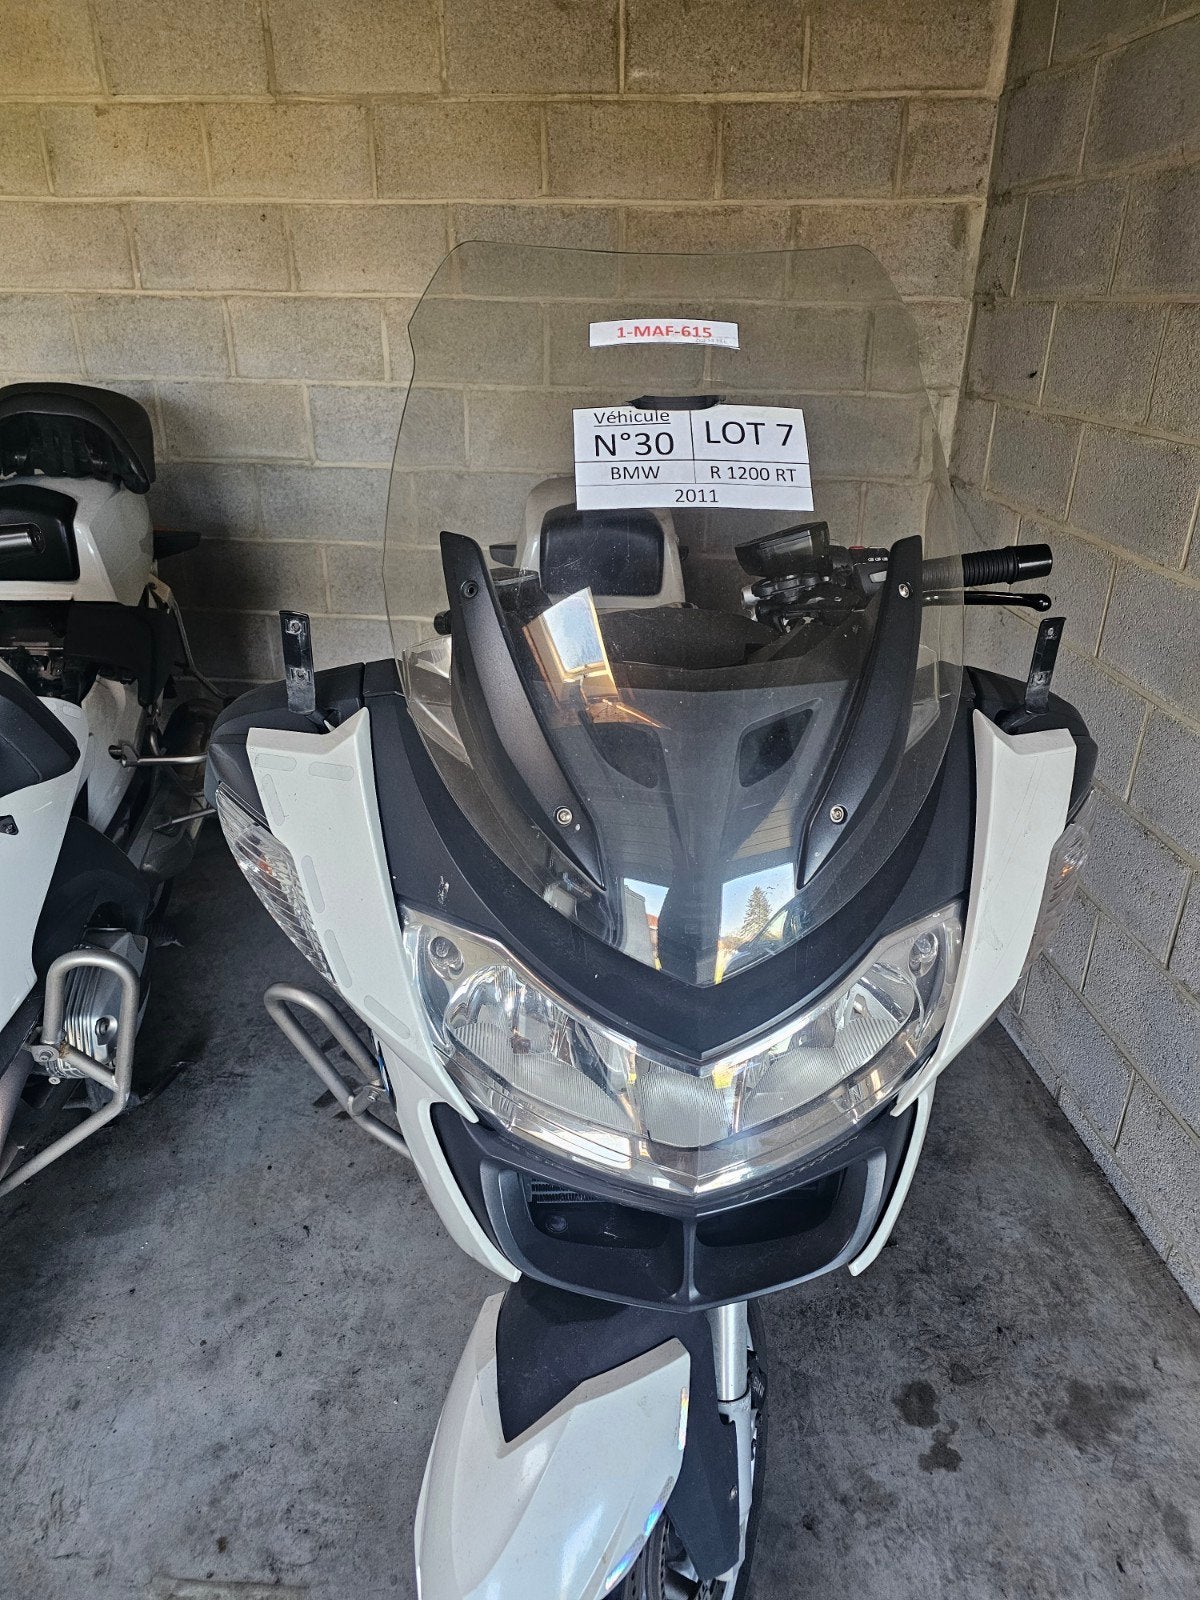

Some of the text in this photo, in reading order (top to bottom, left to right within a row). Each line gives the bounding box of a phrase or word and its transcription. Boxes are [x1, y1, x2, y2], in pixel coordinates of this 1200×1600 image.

[617, 325, 712, 338] 1-MAF-615
[594, 410, 670, 424] Véhicule
[705, 420, 793, 446] LOT 7
[594, 431, 674, 457] N°30
[611, 466, 660, 480] BMW
[710, 466, 797, 482] R 1200 RT
[675, 489, 719, 503] 2011
